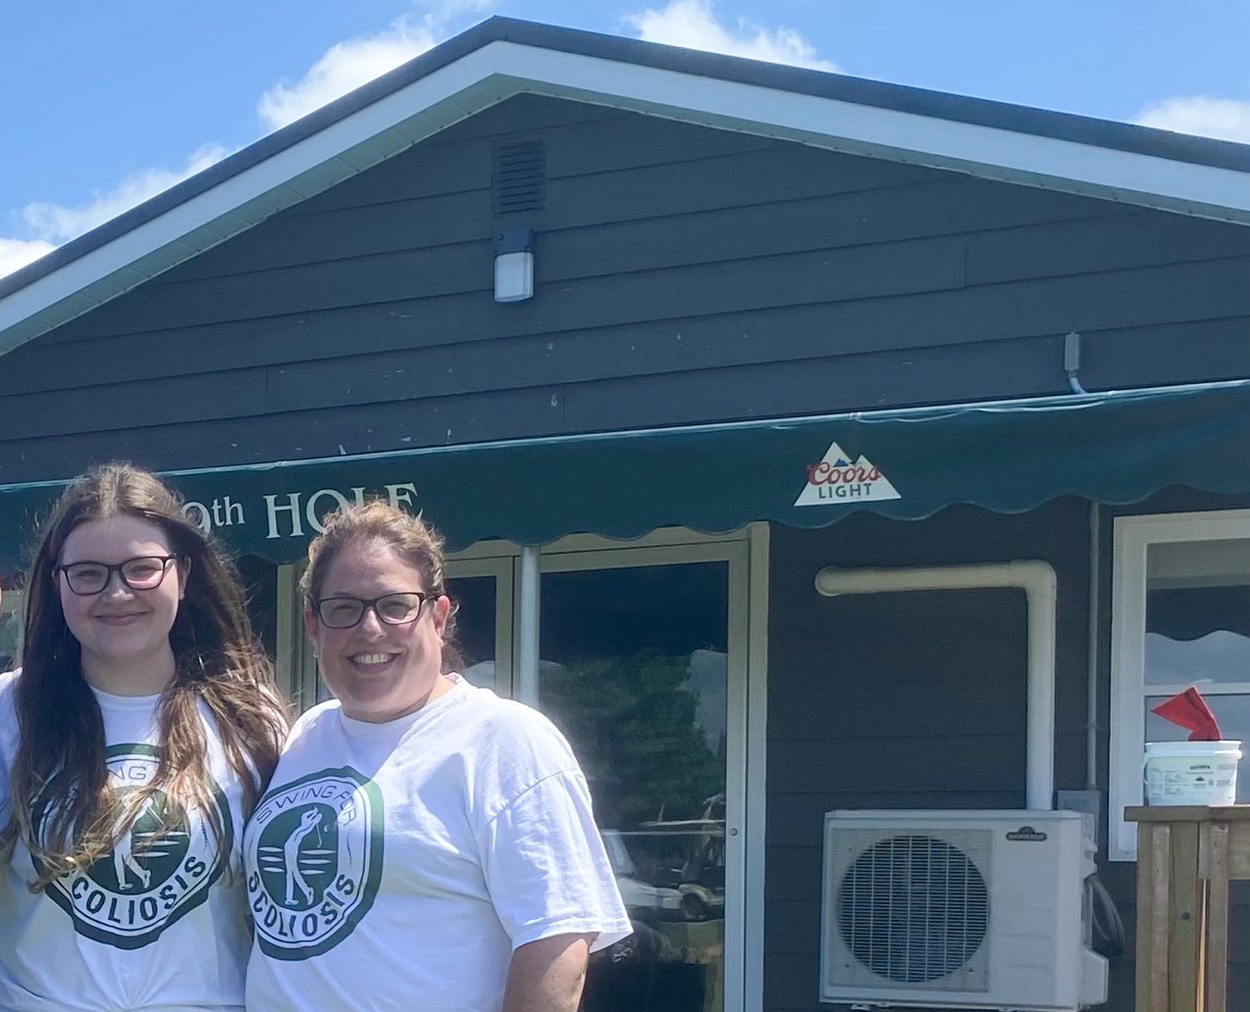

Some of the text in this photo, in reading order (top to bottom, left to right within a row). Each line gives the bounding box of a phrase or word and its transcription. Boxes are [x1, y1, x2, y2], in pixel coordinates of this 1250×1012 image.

[806, 462, 881, 485] Coors
[818, 483, 872, 499] LIGHT
[181, 496, 246, 534] 9th
[257, 785, 337, 824] SWING
[63, 856, 206, 925] COLIOSIS
[249, 871, 354, 937] SCOLIOSIS
